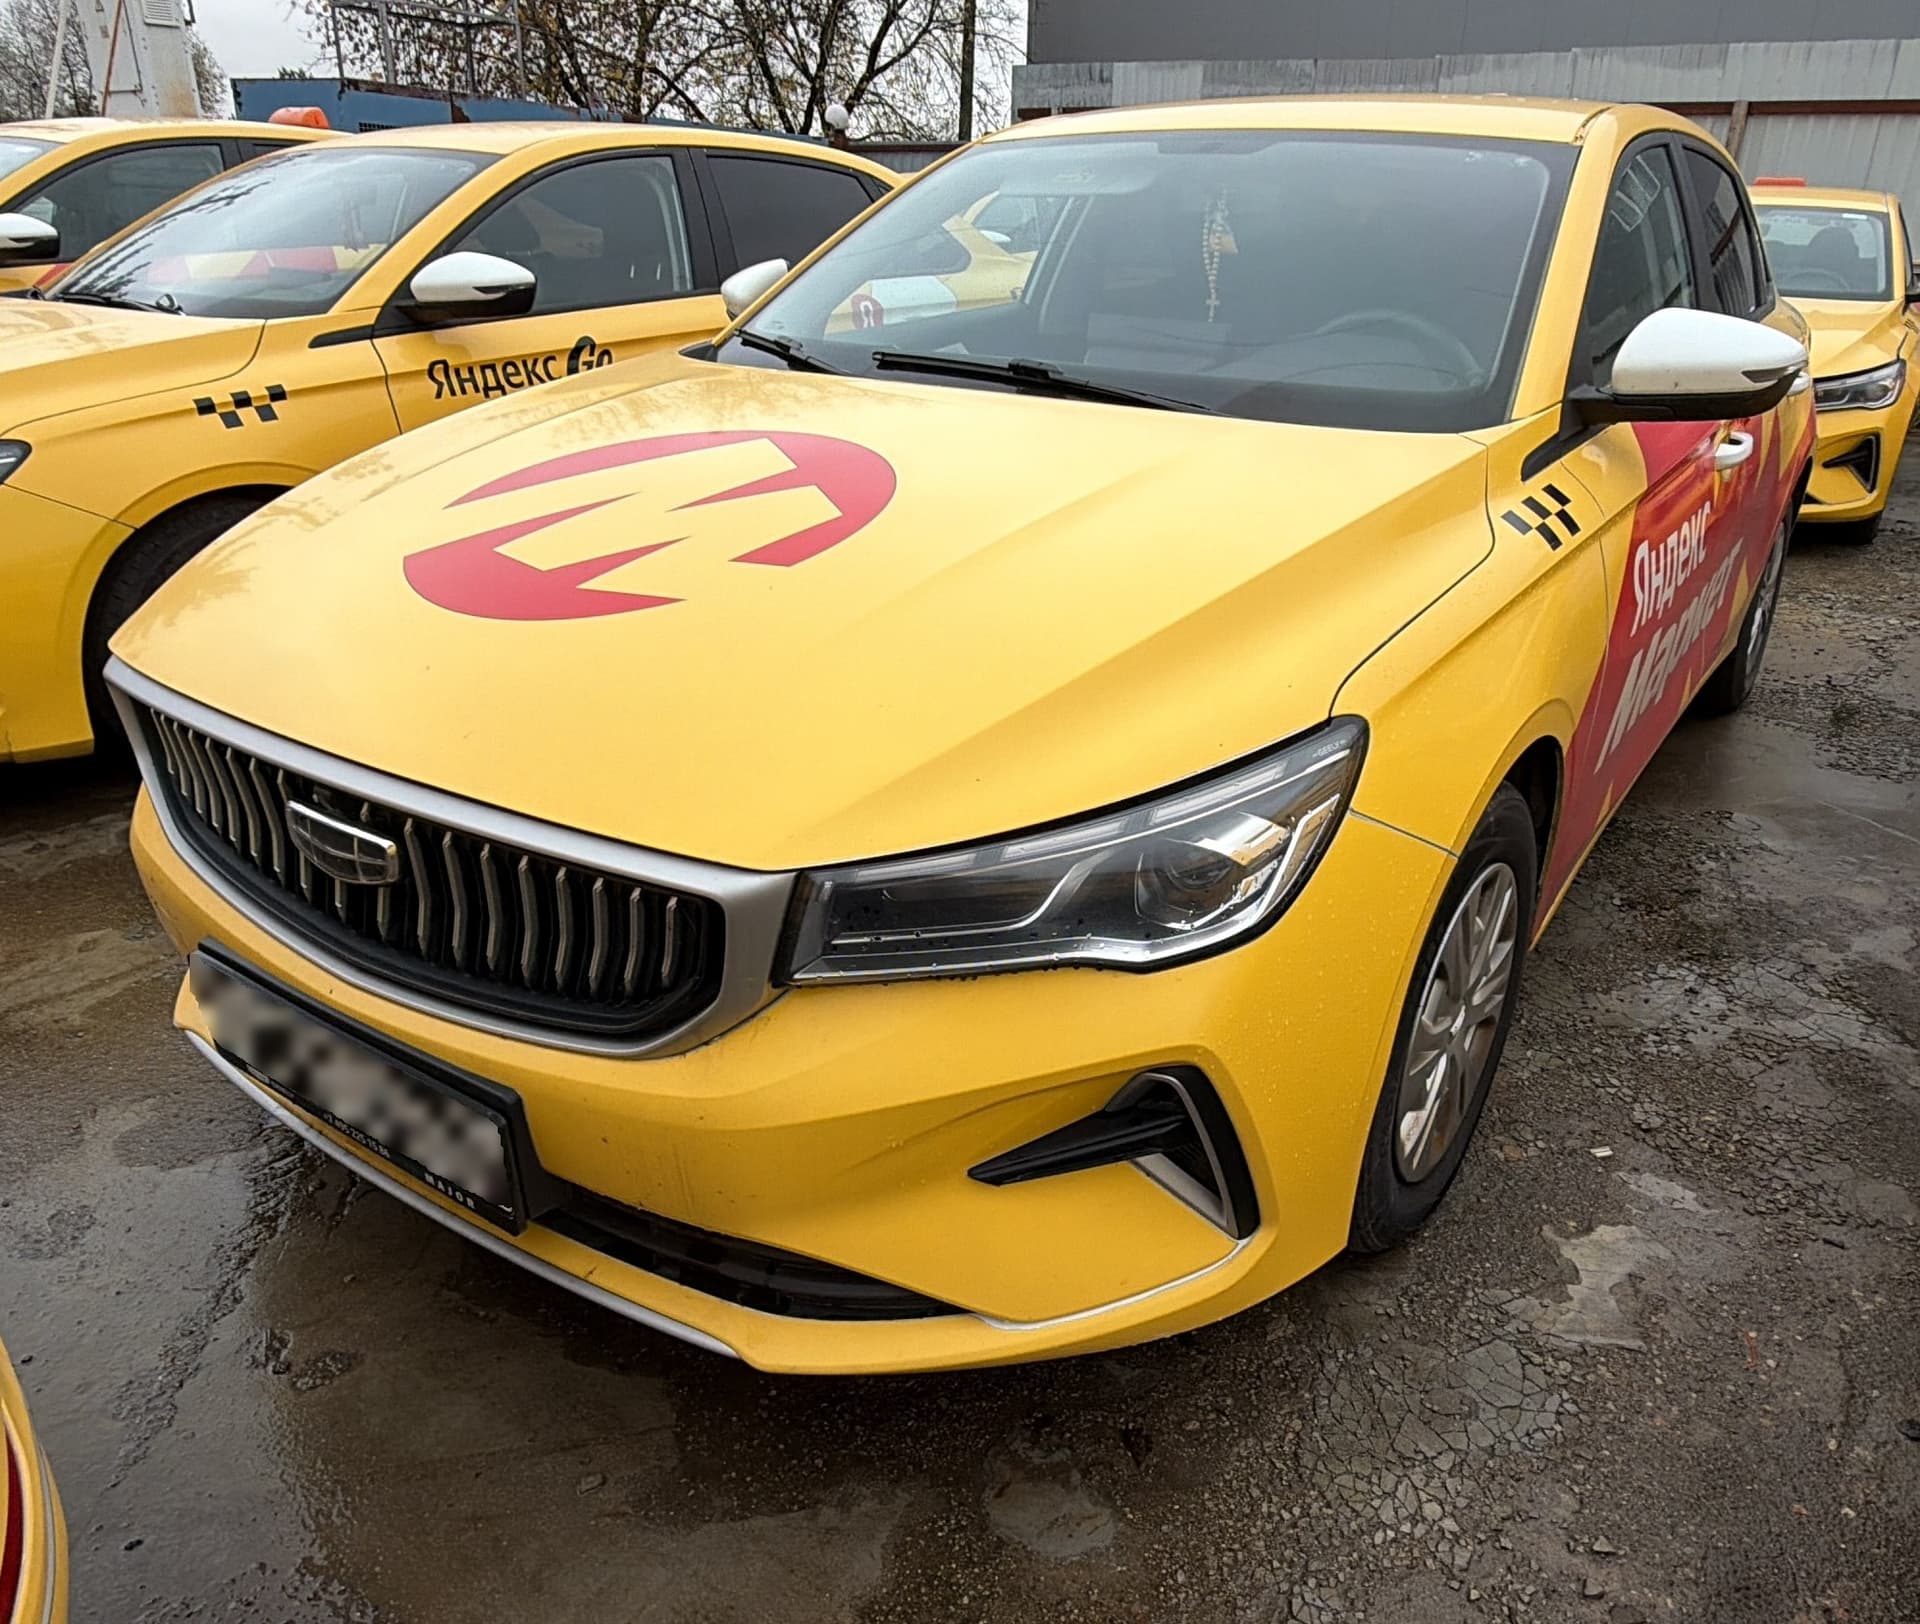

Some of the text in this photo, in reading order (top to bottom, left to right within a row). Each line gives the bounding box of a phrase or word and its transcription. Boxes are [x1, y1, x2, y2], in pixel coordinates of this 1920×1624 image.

[427, 335, 614, 399] Яндекс Go
[1630, 500, 1712, 637] Яндекс
[1593, 536, 1744, 775] Маркет
